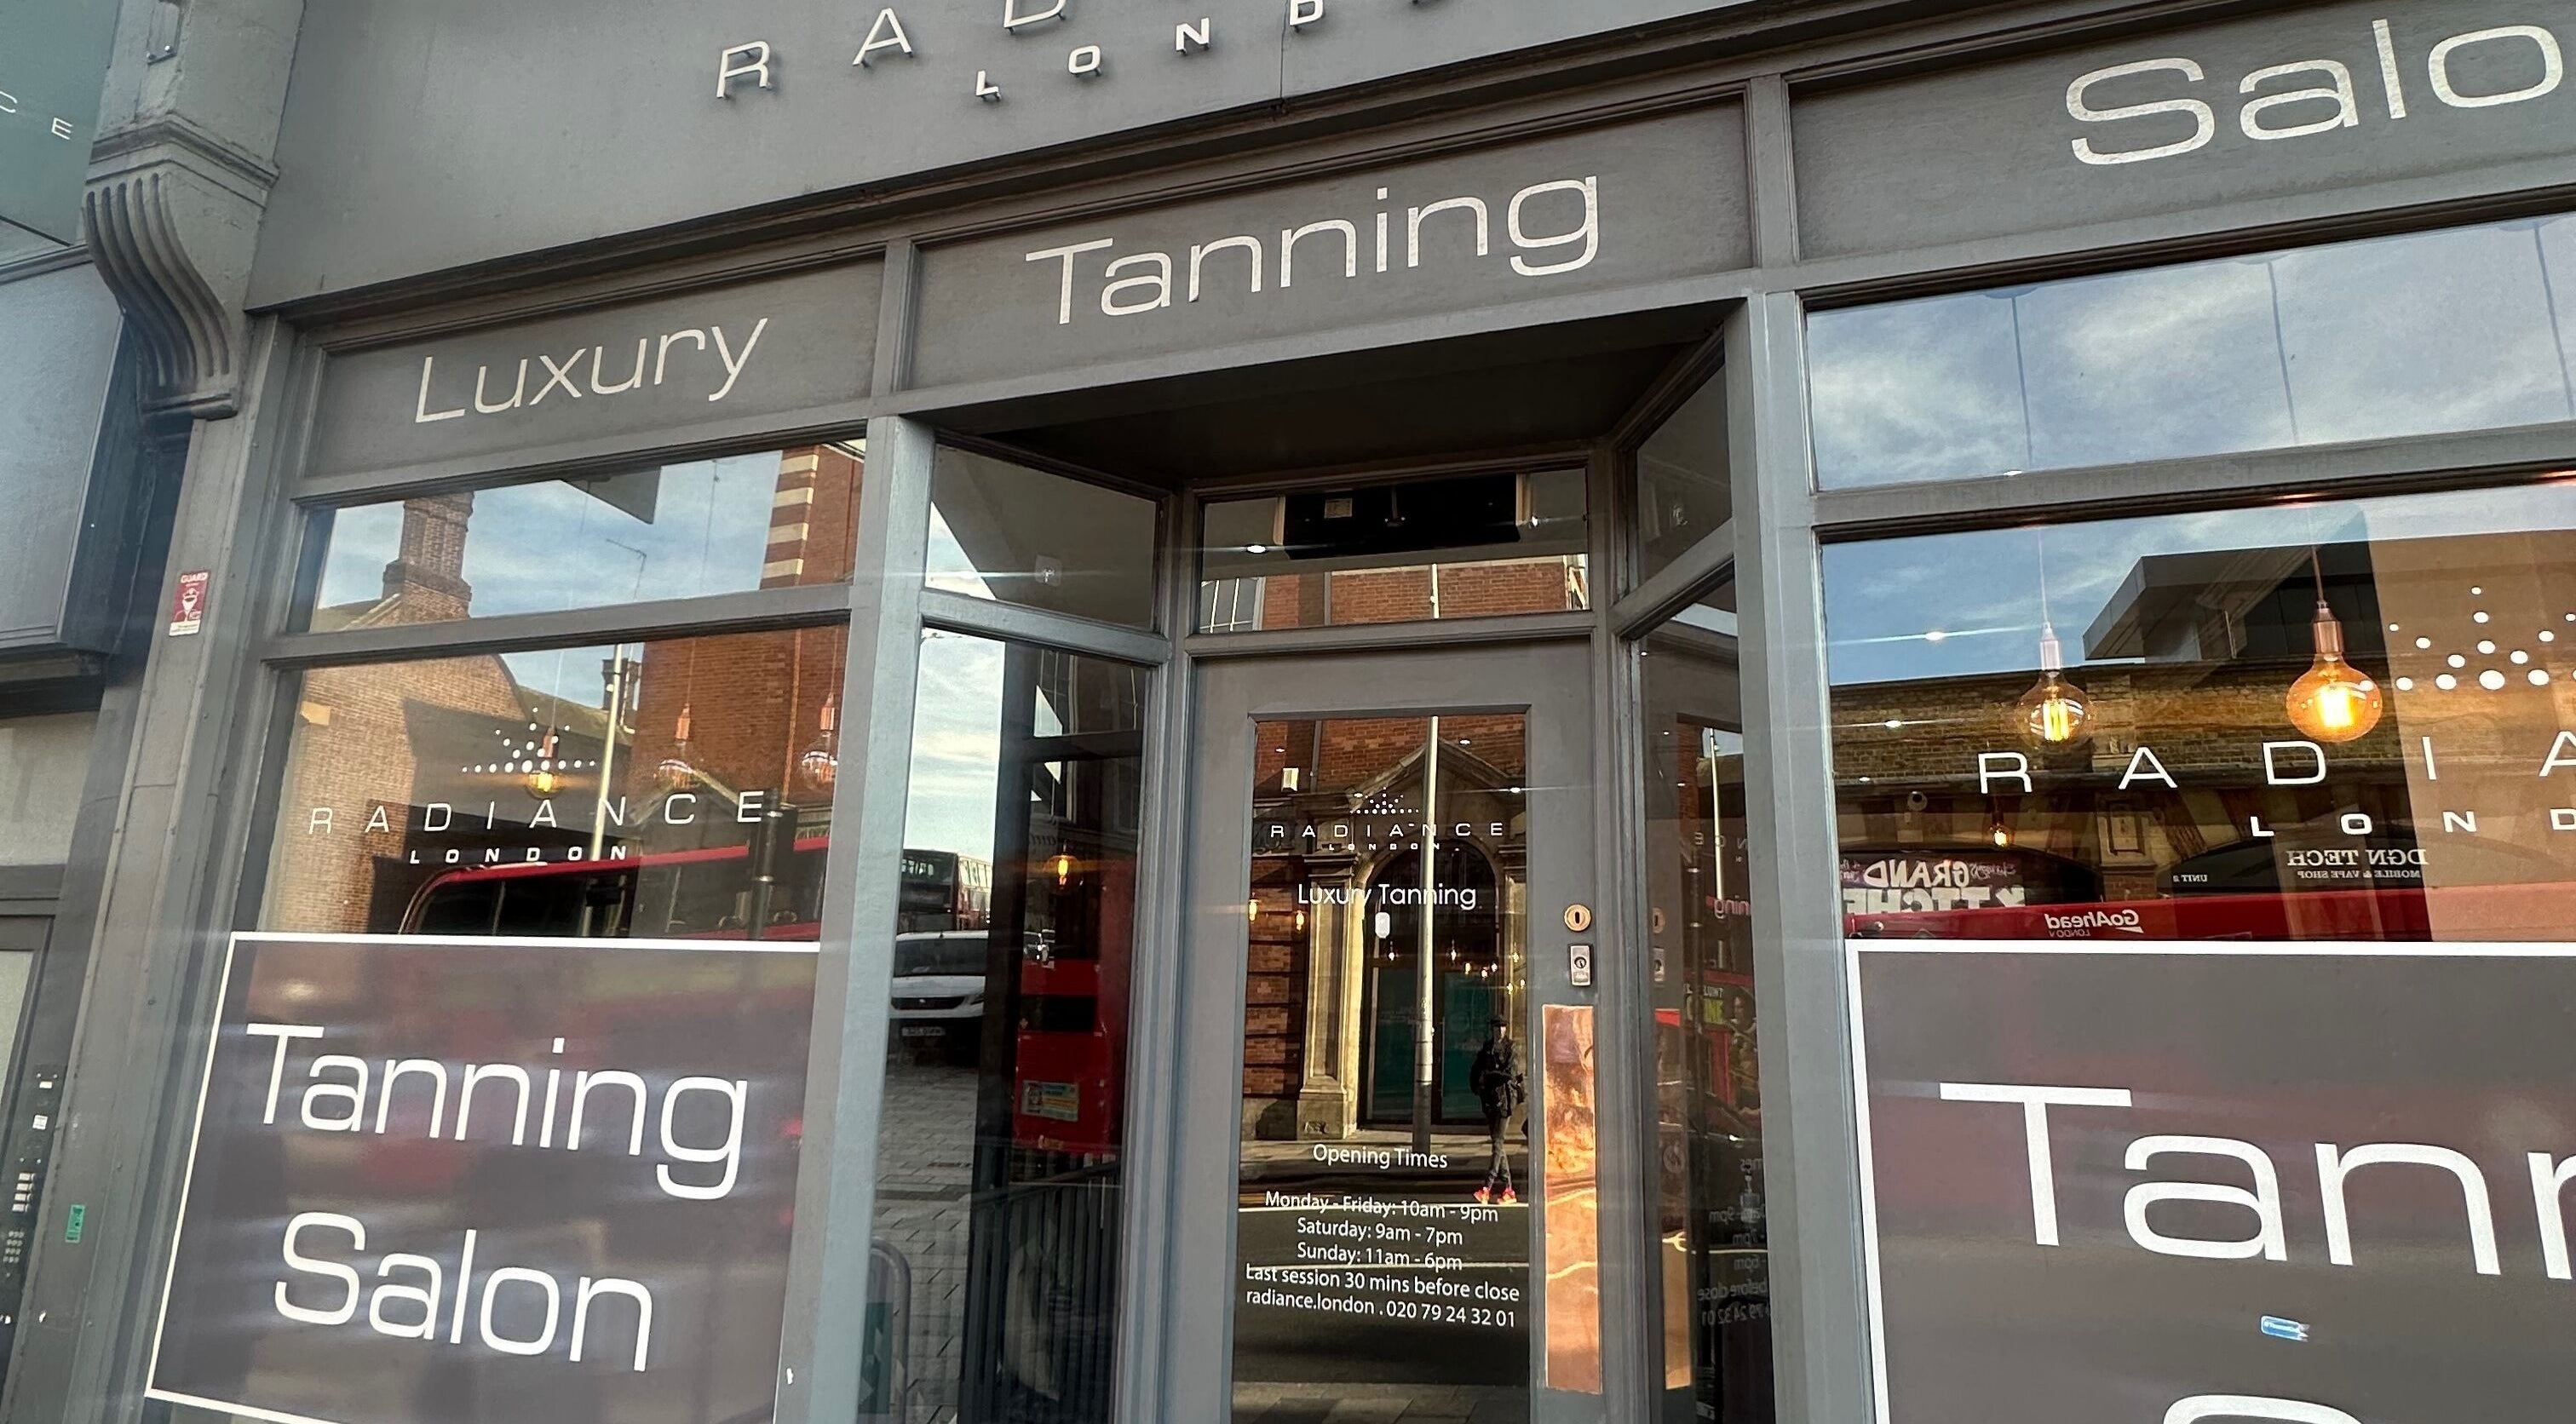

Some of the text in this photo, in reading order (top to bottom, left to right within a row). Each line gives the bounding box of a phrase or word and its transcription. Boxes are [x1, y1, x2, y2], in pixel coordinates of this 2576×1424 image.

[2066, 19, 2563, 165] Salo
[1025, 176, 1600, 326] Tanning
[414, 318, 768, 424] Luxury
[308, 790, 765, 835] RADIANCE
[1270, 823, 1503, 838] RADIANCE
[410, 845, 627, 864] LONDON
[1328, 842, 1440, 851] LONDON
[1298, 883, 1476, 910] Luxury Tanning
[247, 1022, 748, 1200] Tanning
[1313, 1144, 1448, 1169] Opening Times
[1939, 1082, 2576, 1280] Tan
[1265, 1191, 1329, 1214] Monday
[1343, 1196, 1397, 1219] Friday:
[1401, 1200, 1446, 1219] 10am
[1460, 1205, 1498, 1225] 9pm
[1297, 1217, 1372, 1242] Saturday:
[1375, 1223, 1411, 1242] 9am
[1426, 1226, 1463, 1248] 7pm
[1297, 1242, 1361, 1266] Sunday:
[1366, 1248, 1410, 1266] 11am
[1424, 1252, 1463, 1272] 6pm
[274, 1212, 653, 1372] Salon
[1246, 1263, 1520, 1301] Last session 30 mins before close
[1246, 1288, 1375, 1315] radiance.london
[1386, 1300, 1417, 1318] 020
[1421, 1304, 1441, 1321] 79
[1446, 1306, 1466, 1323] 24
[1470, 1307, 1492, 1325] 32
[1496, 1310, 1515, 1328] 01
